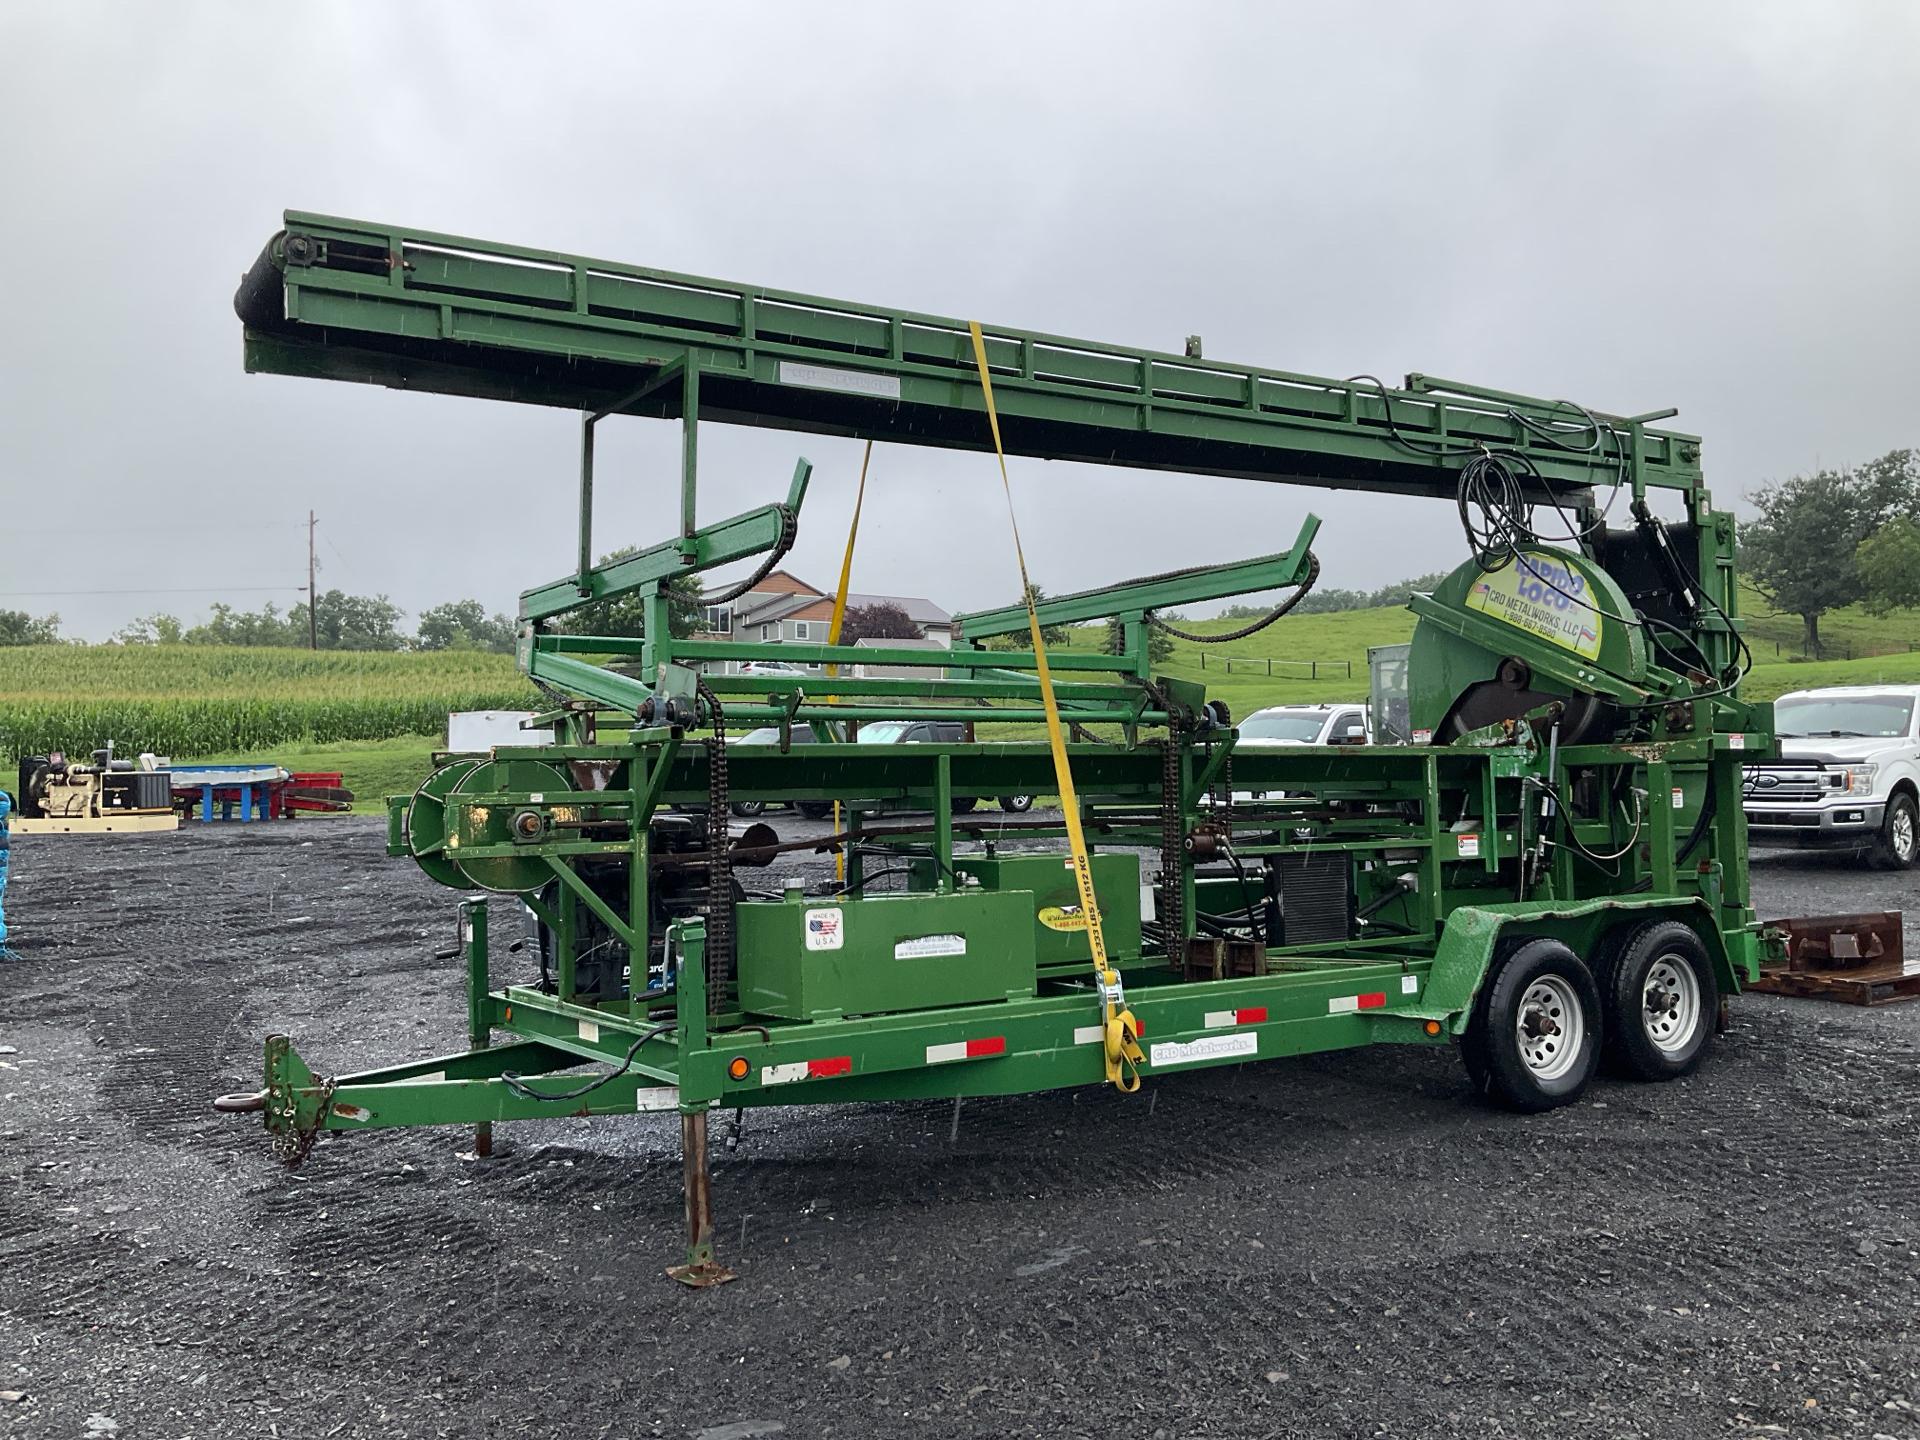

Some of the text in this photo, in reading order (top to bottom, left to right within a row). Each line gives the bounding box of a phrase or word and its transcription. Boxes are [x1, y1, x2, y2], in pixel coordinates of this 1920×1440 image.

[1518, 576, 1570, 611] LOCO
[1489, 590, 1505, 605] CRD
[1505, 596, 1561, 630] METALWORKS,
[1562, 620, 1579, 636] LLC
[1078, 855, 1087, 871] KG
[1082, 874, 1091, 897] 1512
[1088, 907, 1098, 926] LBS
[1153, 1047, 1179, 1060] CRD
